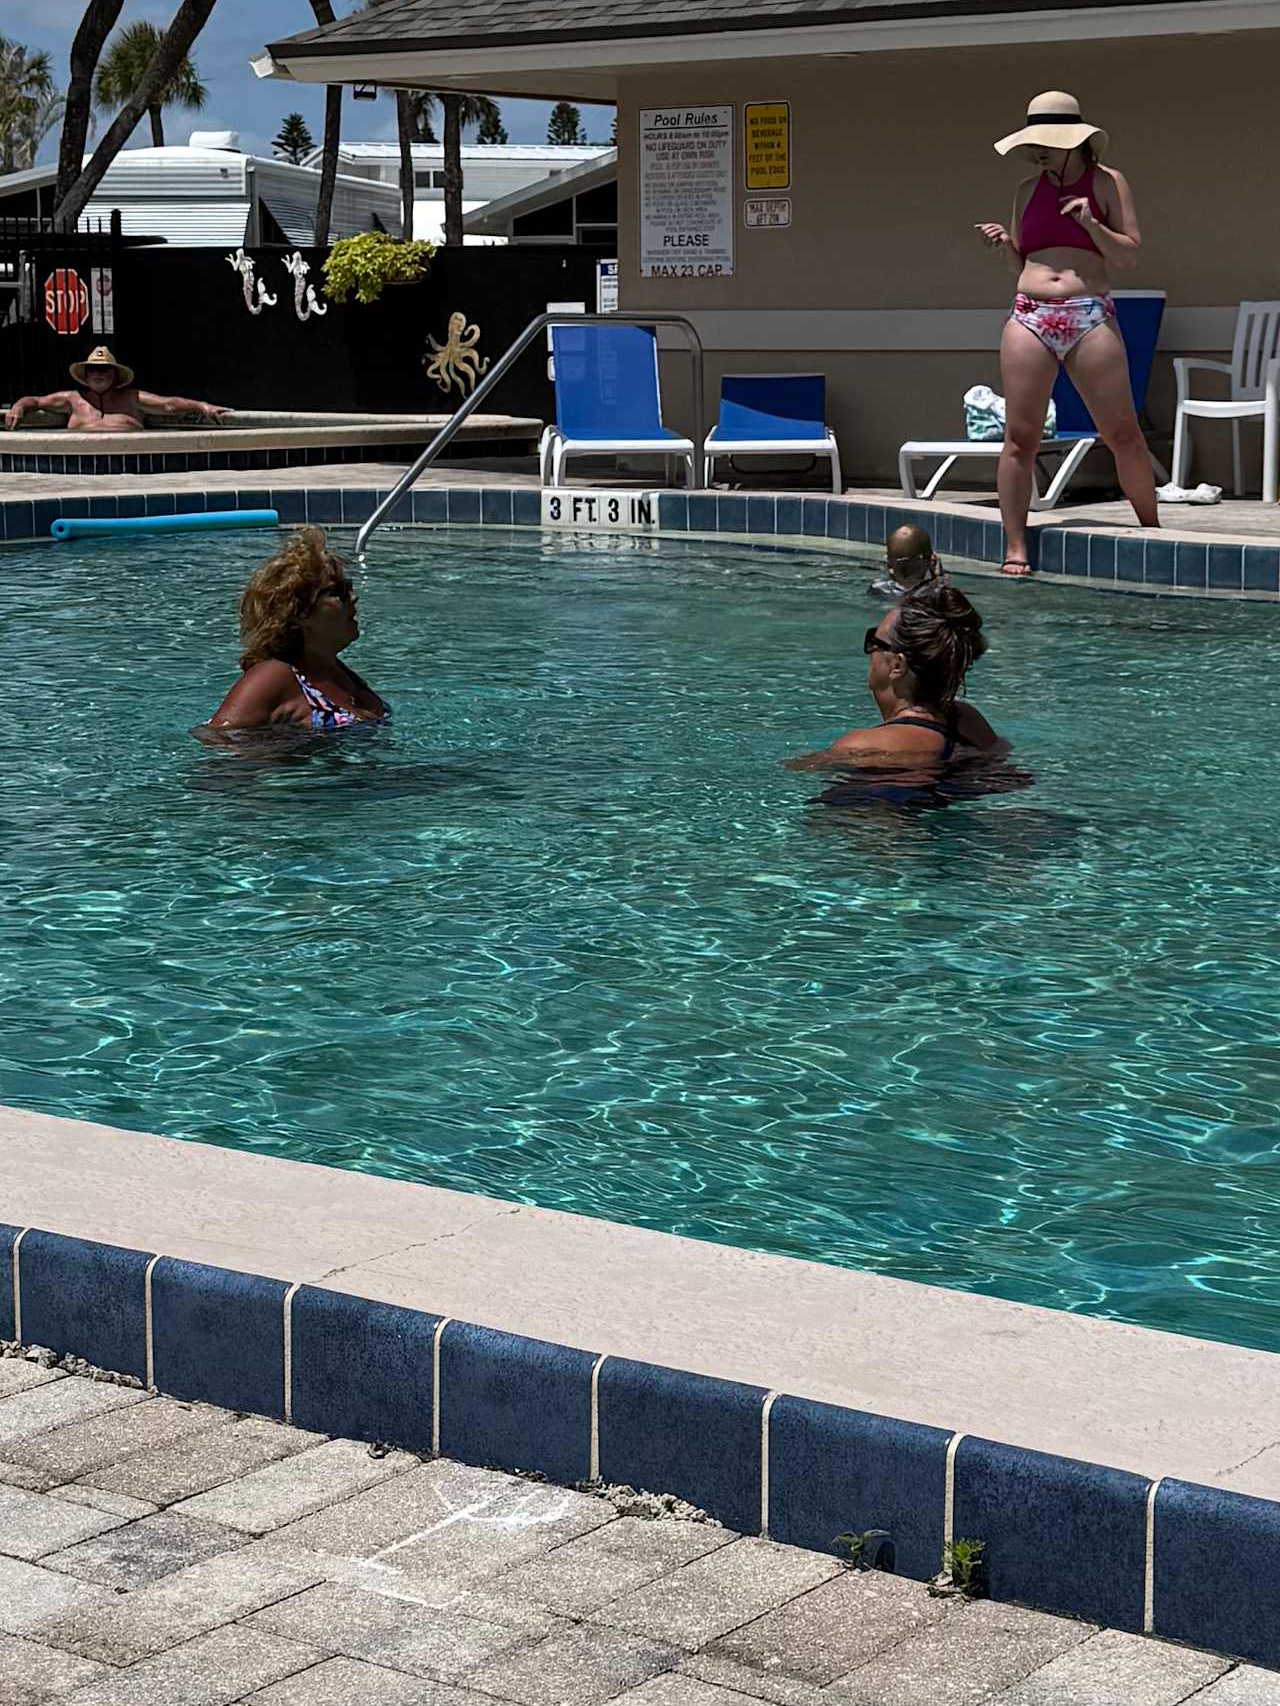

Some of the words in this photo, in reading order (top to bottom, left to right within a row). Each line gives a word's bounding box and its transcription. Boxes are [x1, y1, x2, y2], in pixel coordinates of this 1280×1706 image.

[654, 113, 680, 126] Pool
[685, 112, 718, 125] Rules
[645, 142, 656, 151] NO
[658, 141, 695, 151] LIFEGUARD
[696, 141, 706, 150] ON
[708, 140, 727, 149] DUTY
[656, 152, 669, 161] USE
[671, 151, 680, 160] AT
[681, 151, 698, 160] OWN
[663, 234, 710, 247] PLEASE
[651, 265, 678, 277] MAX
[681, 265, 694, 277] 23
[550, 496, 561, 520] 3
[573, 497, 597, 522] FT.
[608, 498, 619, 522] 3
[631, 498, 655, 524] IN.
